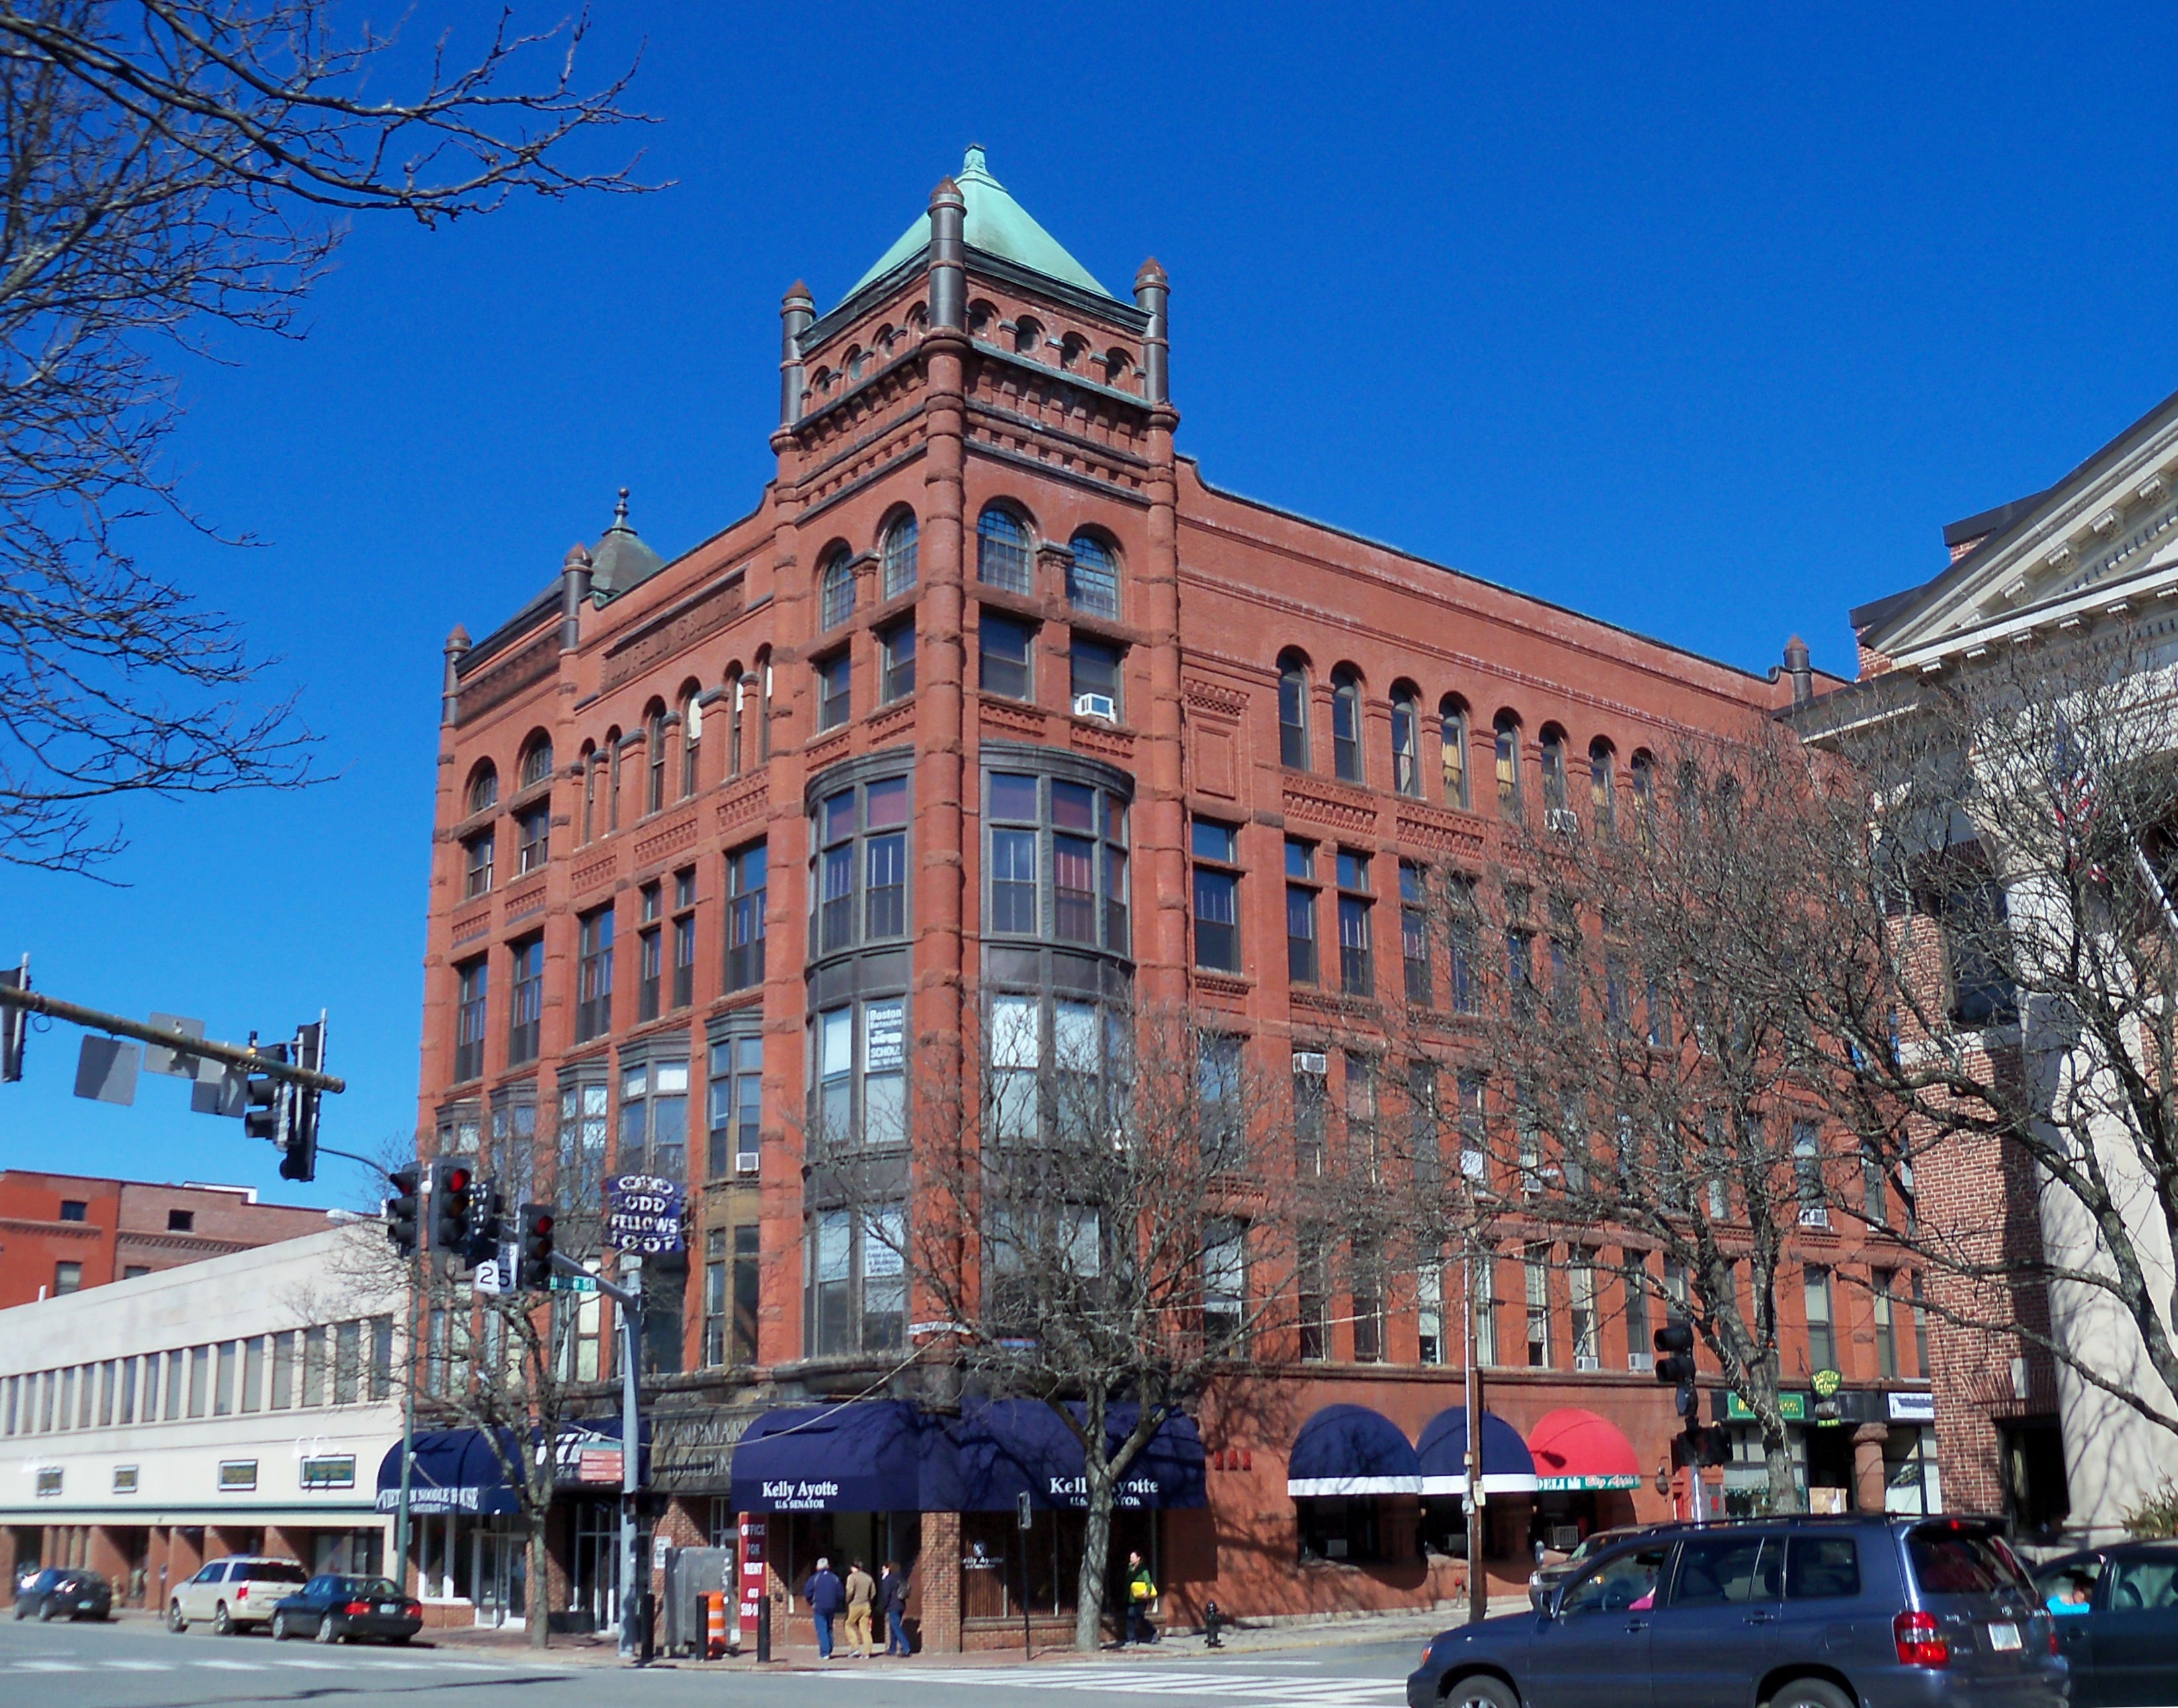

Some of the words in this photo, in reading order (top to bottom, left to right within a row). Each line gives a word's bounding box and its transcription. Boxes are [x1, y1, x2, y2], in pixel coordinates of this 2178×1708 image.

[870, 1008, 902, 1022] Boston
[625, 1195, 666, 1212] ODD
[611, 1214, 677, 1234] FELLOWS
[480, 1266, 511, 1288] 25
[667, 1454, 732, 1478] BUILDIN
[762, 1481, 796, 1501] Kelly
[797, 1480, 839, 1500] Ayotte
[1049, 1477, 1088, 1494] Kell
[1111, 1478, 1159, 1497] yotte
[376, 1488, 417, 1509] VIETM
[417, 1488, 450, 1502] NOODLE
[450, 1487, 479, 1510] HUSE
[789, 1499, 825, 1509] SENATOR
[741, 1524, 765, 1537] OFFICE
[746, 1543, 761, 1555] FOR
[743, 1562, 763, 1575] RENT
